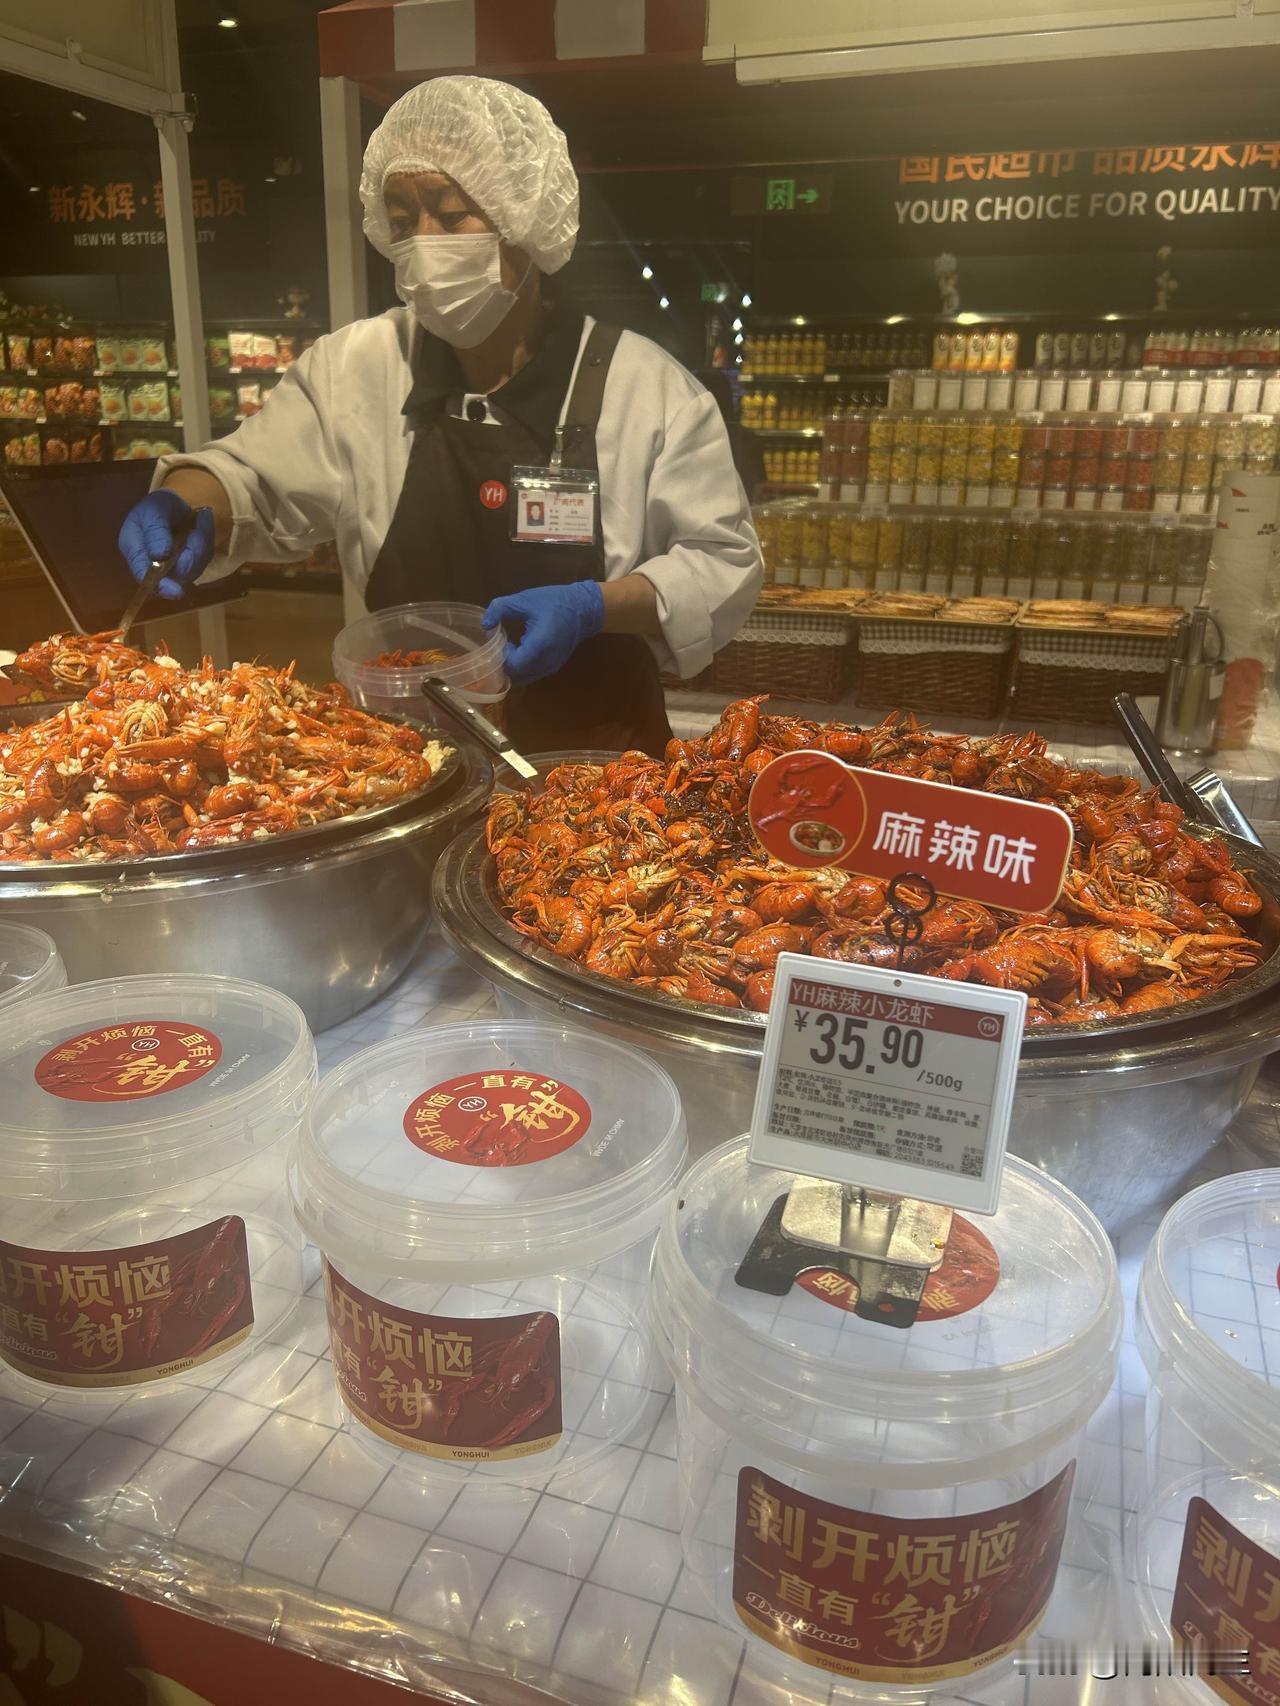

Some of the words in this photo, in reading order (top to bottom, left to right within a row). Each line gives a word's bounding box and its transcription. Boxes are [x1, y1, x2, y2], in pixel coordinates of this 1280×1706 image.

[895, 200, 967, 224] YOUR
[975, 194, 1080, 222] CHOICE
[1088, 191, 1147, 218] FOR
[1154, 186, 1280, 221] QUALITY
[121, 231, 166, 245] BETTER
[485, 487, 503, 502] YH
[872, 810, 1037, 884] 麻辣味
[791, 981, 935, 1027] YH麻辣小龙虾
[453, 1074, 537, 1092] 一直有
[916, 1069, 963, 1092] /500g
[0, 1255, 172, 1305] 开烦恼
[156, 1359, 194, 1375] YONGHUI
[452, 1450, 490, 1458] YONGHUI
[746, 1483, 1021, 1588] 剥开烦恼
[742, 1554, 859, 1627] 一直有
[815, 1656, 861, 1675] YONGHUI
